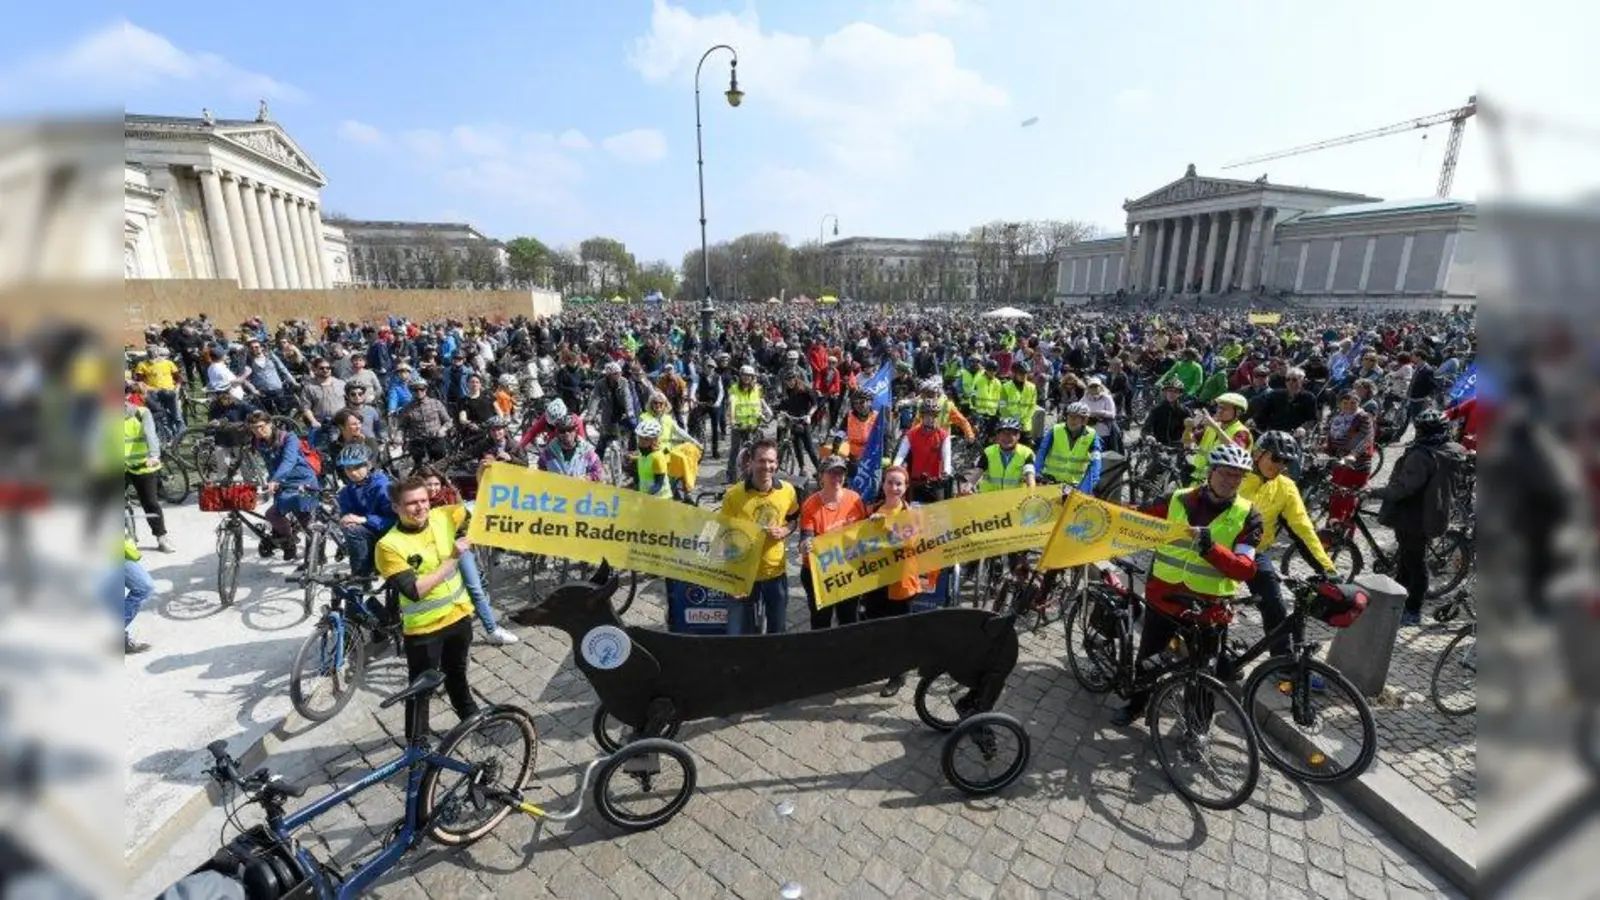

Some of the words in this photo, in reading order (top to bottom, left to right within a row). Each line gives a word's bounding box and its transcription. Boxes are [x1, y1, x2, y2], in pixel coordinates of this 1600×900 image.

[489, 484, 568, 514] Platz
[575, 492, 620, 519] da!
[485, 514, 525, 534] Für
[528, 517, 569, 537] den
[823, 569, 855, 594] Für
[856, 554, 890, 578] den
[893, 512, 1013, 563] Radentscheid
